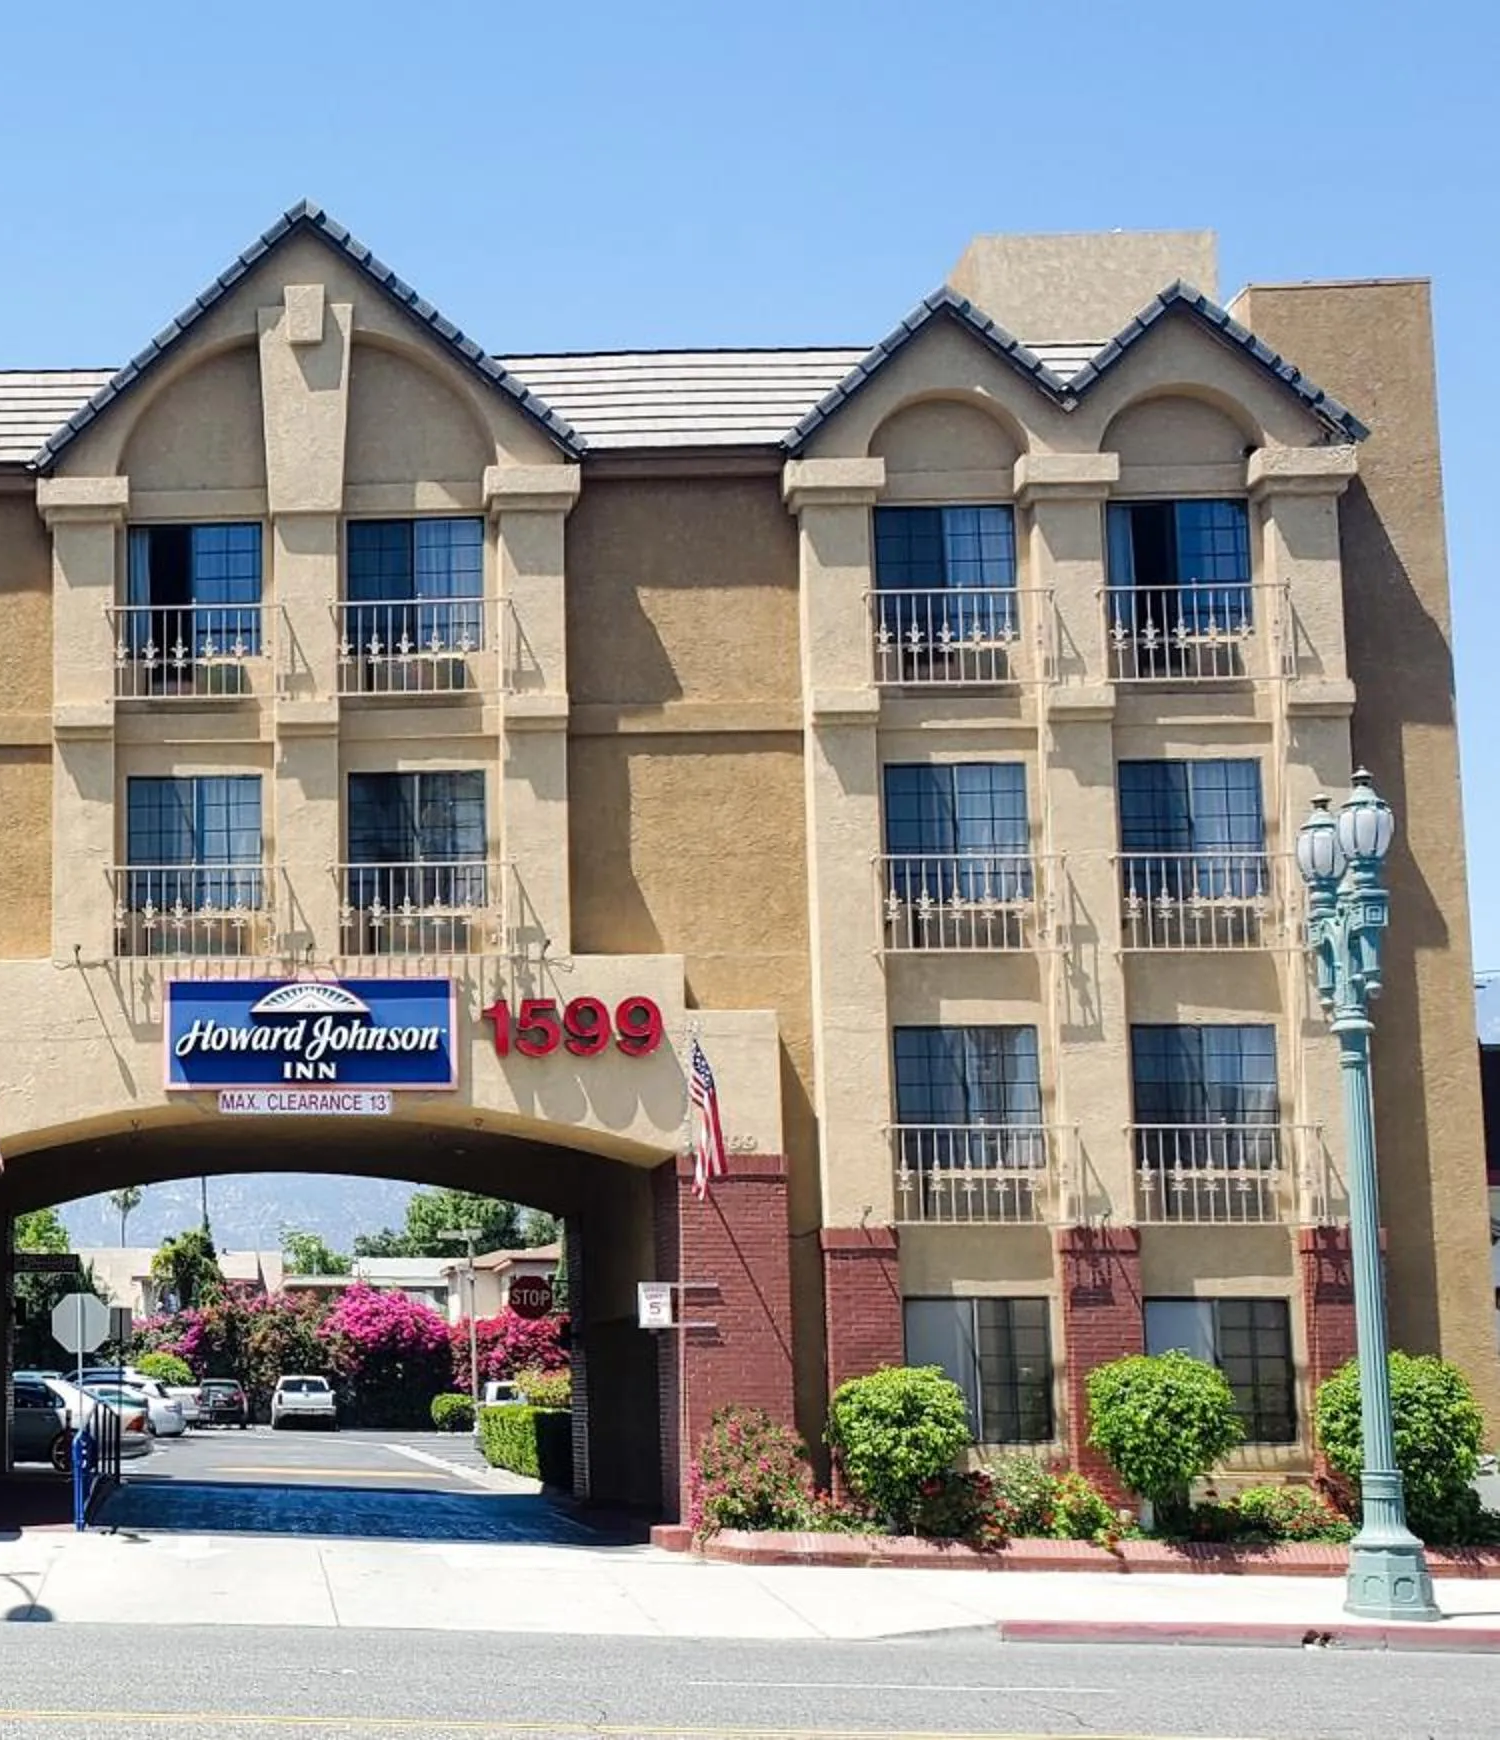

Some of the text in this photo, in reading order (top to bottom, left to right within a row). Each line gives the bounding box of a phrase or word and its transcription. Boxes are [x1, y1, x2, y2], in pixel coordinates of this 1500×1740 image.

[482, 996, 663, 1057] 1599
[174, 1015, 440, 1061] Howard Johnson
[283, 1061, 337, 1080] INN
[220, 1093, 260, 1111] MAX.
[267, 1093, 362, 1111] CLEARANCE
[511, 1288, 551, 1307] STOP
[649, 1301, 661, 1314] 5
